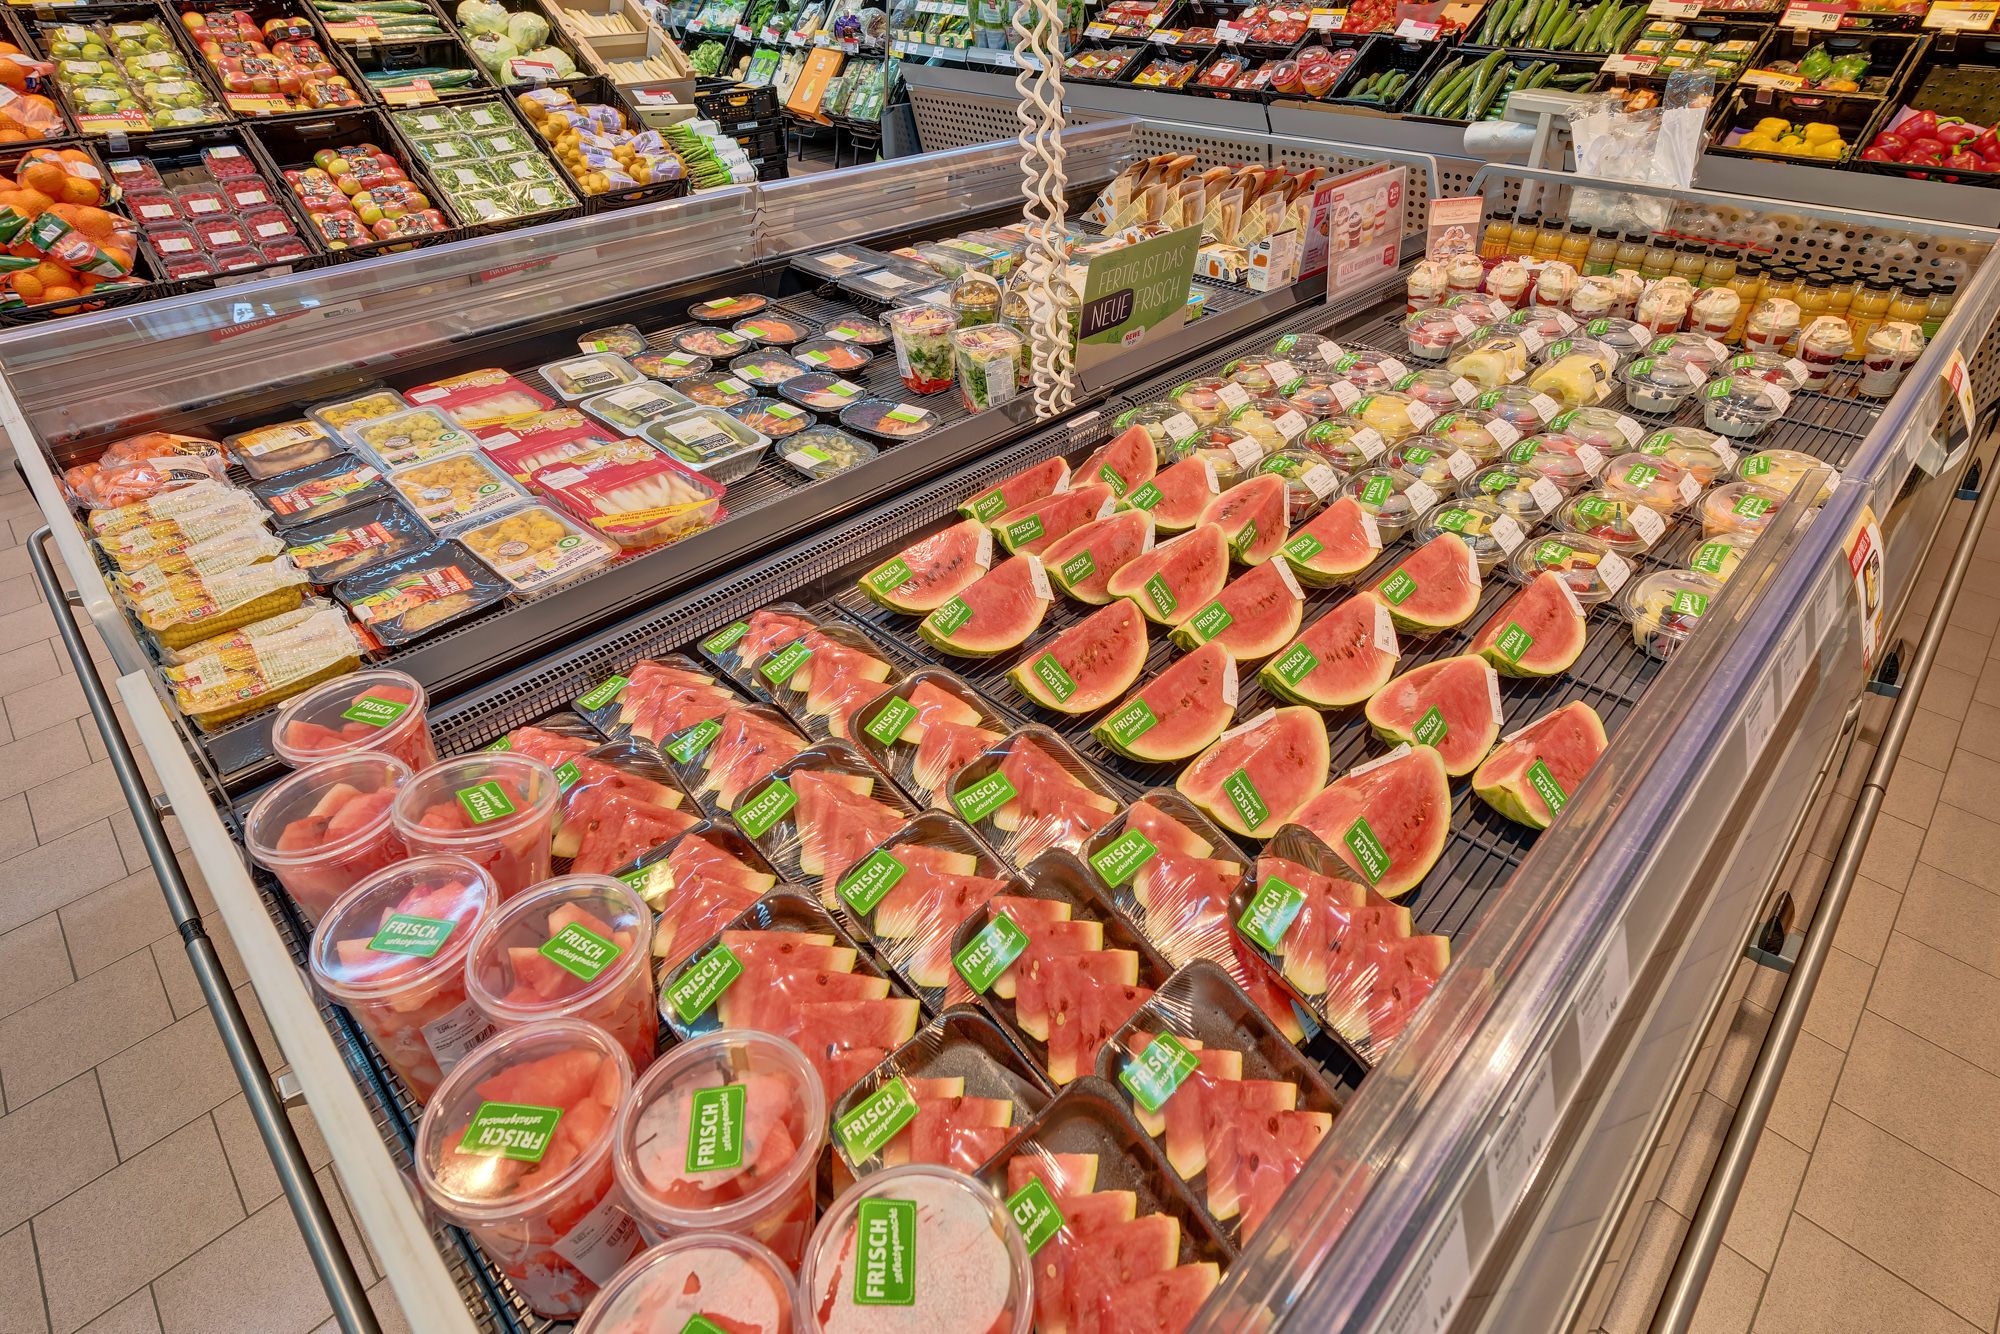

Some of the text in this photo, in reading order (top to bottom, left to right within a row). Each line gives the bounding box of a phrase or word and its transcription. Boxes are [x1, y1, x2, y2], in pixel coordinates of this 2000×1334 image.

[1098, 245, 1186, 295] FERTIG IST DAS
[1091, 277, 1181, 330] NEUE FRISCH.
[1125, 330, 1141, 341] REWE
[977, 495, 998, 513] FRISCH
[1132, 486, 1152, 504] FRISCH
[1008, 520, 1035, 537] FRISCH
[1287, 538, 1311, 555] FRISCH
[872, 563, 900, 584] FRISCH
[1063, 556, 1086, 576] FRISCH
[1383, 573, 1405, 595] FRISCH
[934, 601, 960, 626] FRISCH
[1151, 585, 1170, 615] FRISCH
[1195, 608, 1220, 630] FRISCH
[1500, 629, 1520, 652] FRISCH
[763, 650, 798, 677] FRISCH
[1278, 650, 1305, 675] FRISCH
[582, 682, 615, 706] FRISCH
[1040, 666, 1068, 698] FRISCH
[356, 700, 397, 714] FRISCH
[871, 706, 901, 735] FRISCH
[1113, 706, 1143, 733] FRISCH
[1416, 713, 1438, 740] FRISCH
[671, 728, 707, 757] FRISCH
[466, 791, 496, 818] FRISCH
[740, 790, 780, 826] FRISCH
[957, 780, 999, 810] FRISCH
[1231, 784, 1259, 825] FRISCH
[1096, 838, 1137, 872] FRISCH
[1353, 835, 1381, 878] FRISCH
[844, 861, 886, 900] FRISCH
[1245, 888, 1282, 937] FRISCH
[384, 921, 442, 938] FRISCH
[557, 929, 606, 960] FRISCH
[961, 926, 1006, 974] FRISCH
[672, 956, 721, 1007] FRISCH
[1129, 1041, 1176, 1093] FRISCH
[841, 1093, 895, 1143] FRISCH
[476, 1126, 546, 1149] FRISCH
[697, 1102, 719, 1165] FRISCH
[866, 1218, 887, 1296] FRISCH
